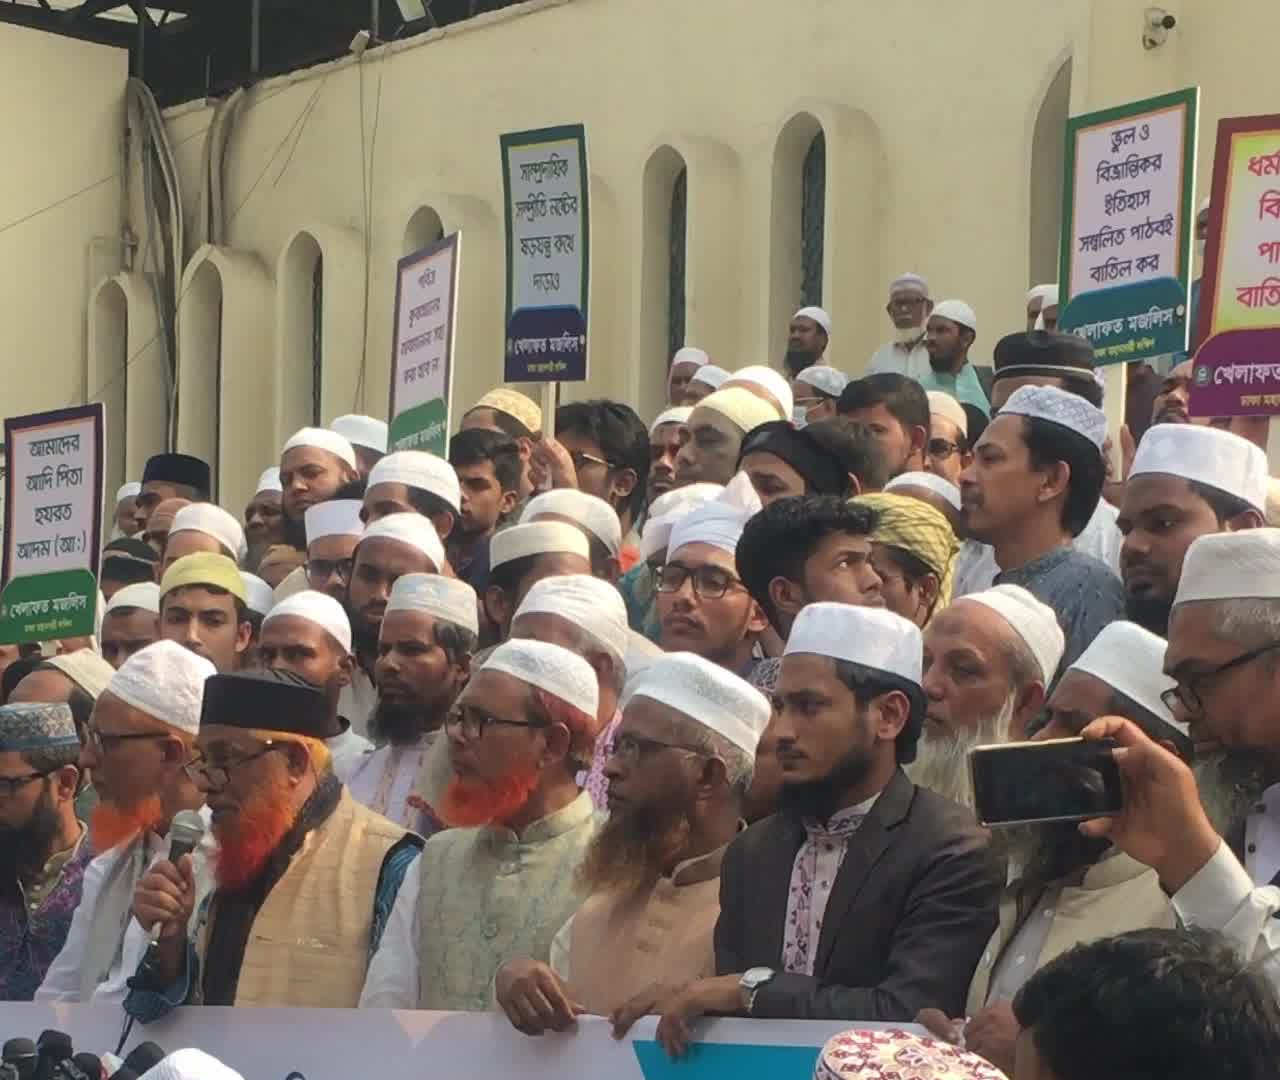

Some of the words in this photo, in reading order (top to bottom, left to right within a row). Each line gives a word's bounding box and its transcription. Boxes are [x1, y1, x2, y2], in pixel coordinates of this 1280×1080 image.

[1111, 126, 1136, 152] ভুল
[1139, 124, 1150, 141] ও
[1096, 153, 1162, 184] বিভ্রান্তিকর
[1104, 189, 1151, 216] ইতিহাস
[1078, 225, 1126, 252] সম্বলিত
[1090, 257, 1132, 283] বাতিল
[1136, 254, 1160, 273] কর
[1128, 305, 1174, 332] মজলিস
[28, 434, 80, 456] আমাদের
[26, 465, 53, 491] আদি
[56, 464, 83, 488] পিতা
[34, 503, 72, 525] হযরত
[17, 540, 51, 559] আদম
